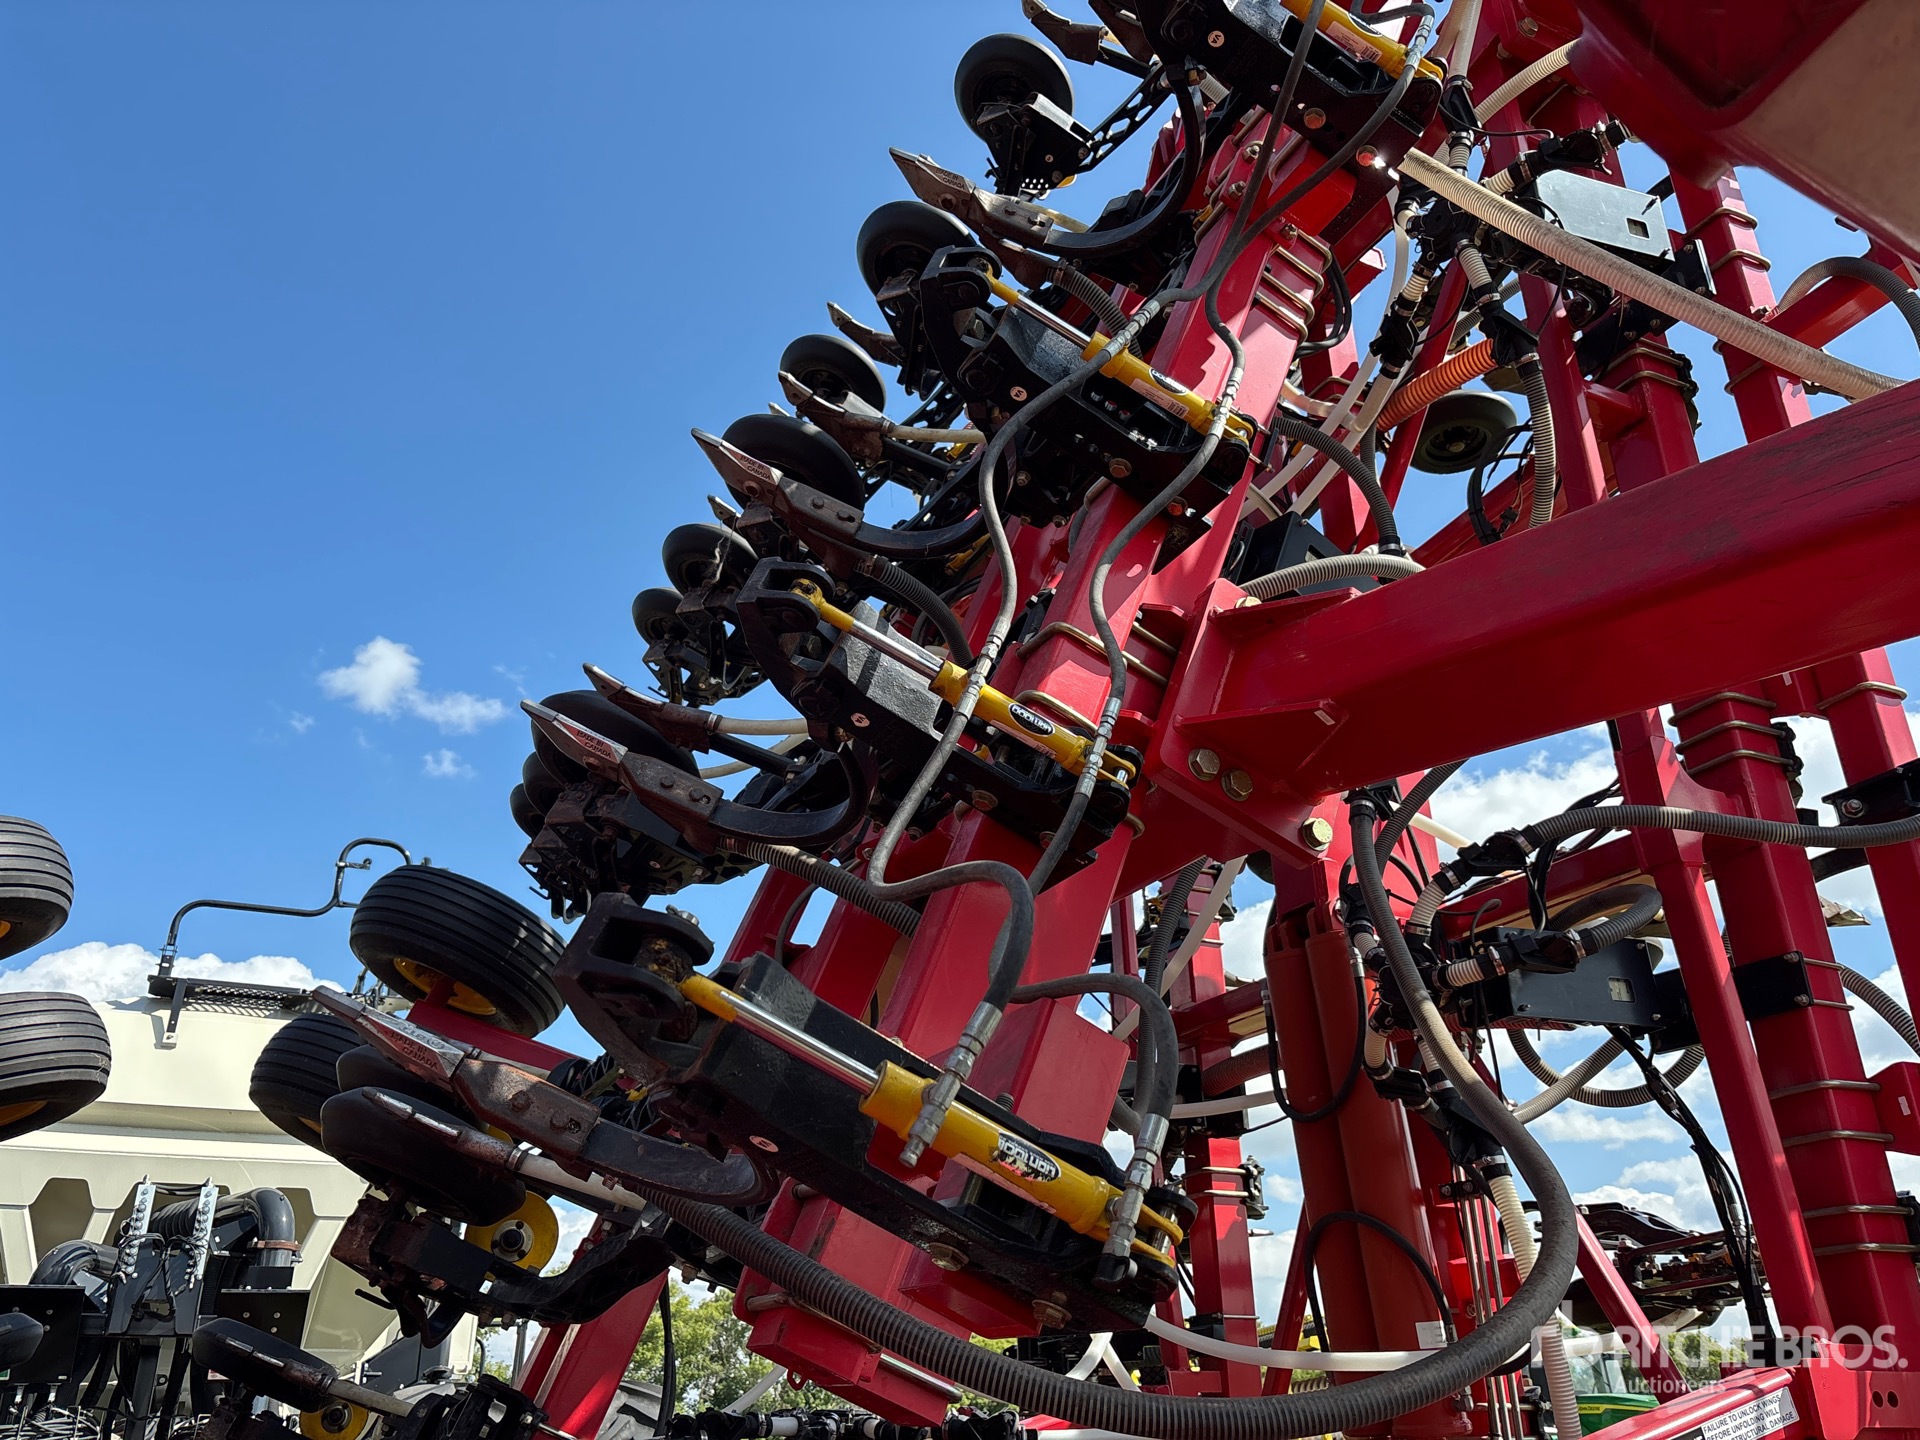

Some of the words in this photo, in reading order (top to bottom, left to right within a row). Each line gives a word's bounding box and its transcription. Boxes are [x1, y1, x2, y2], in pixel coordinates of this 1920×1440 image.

[942, 177, 965, 190] CANADA
[747, 465, 771, 480] CANADA
[577, 730, 597, 744] MADE
[584, 741, 612, 759] CANADA
[389, 1030, 415, 1050] MADE
[401, 1046, 439, 1070] CANADA
[1703, 1417, 1729, 1435] FAILURE
[1728, 1413, 1738, 1423] TO
[1737, 1403, 1762, 1419] UNLOCK
[1760, 1394, 1782, 1409] WINGS
[1731, 1413, 1765, 1434] UNFOLDING
[1763, 1406, 1780, 1419] WILL
